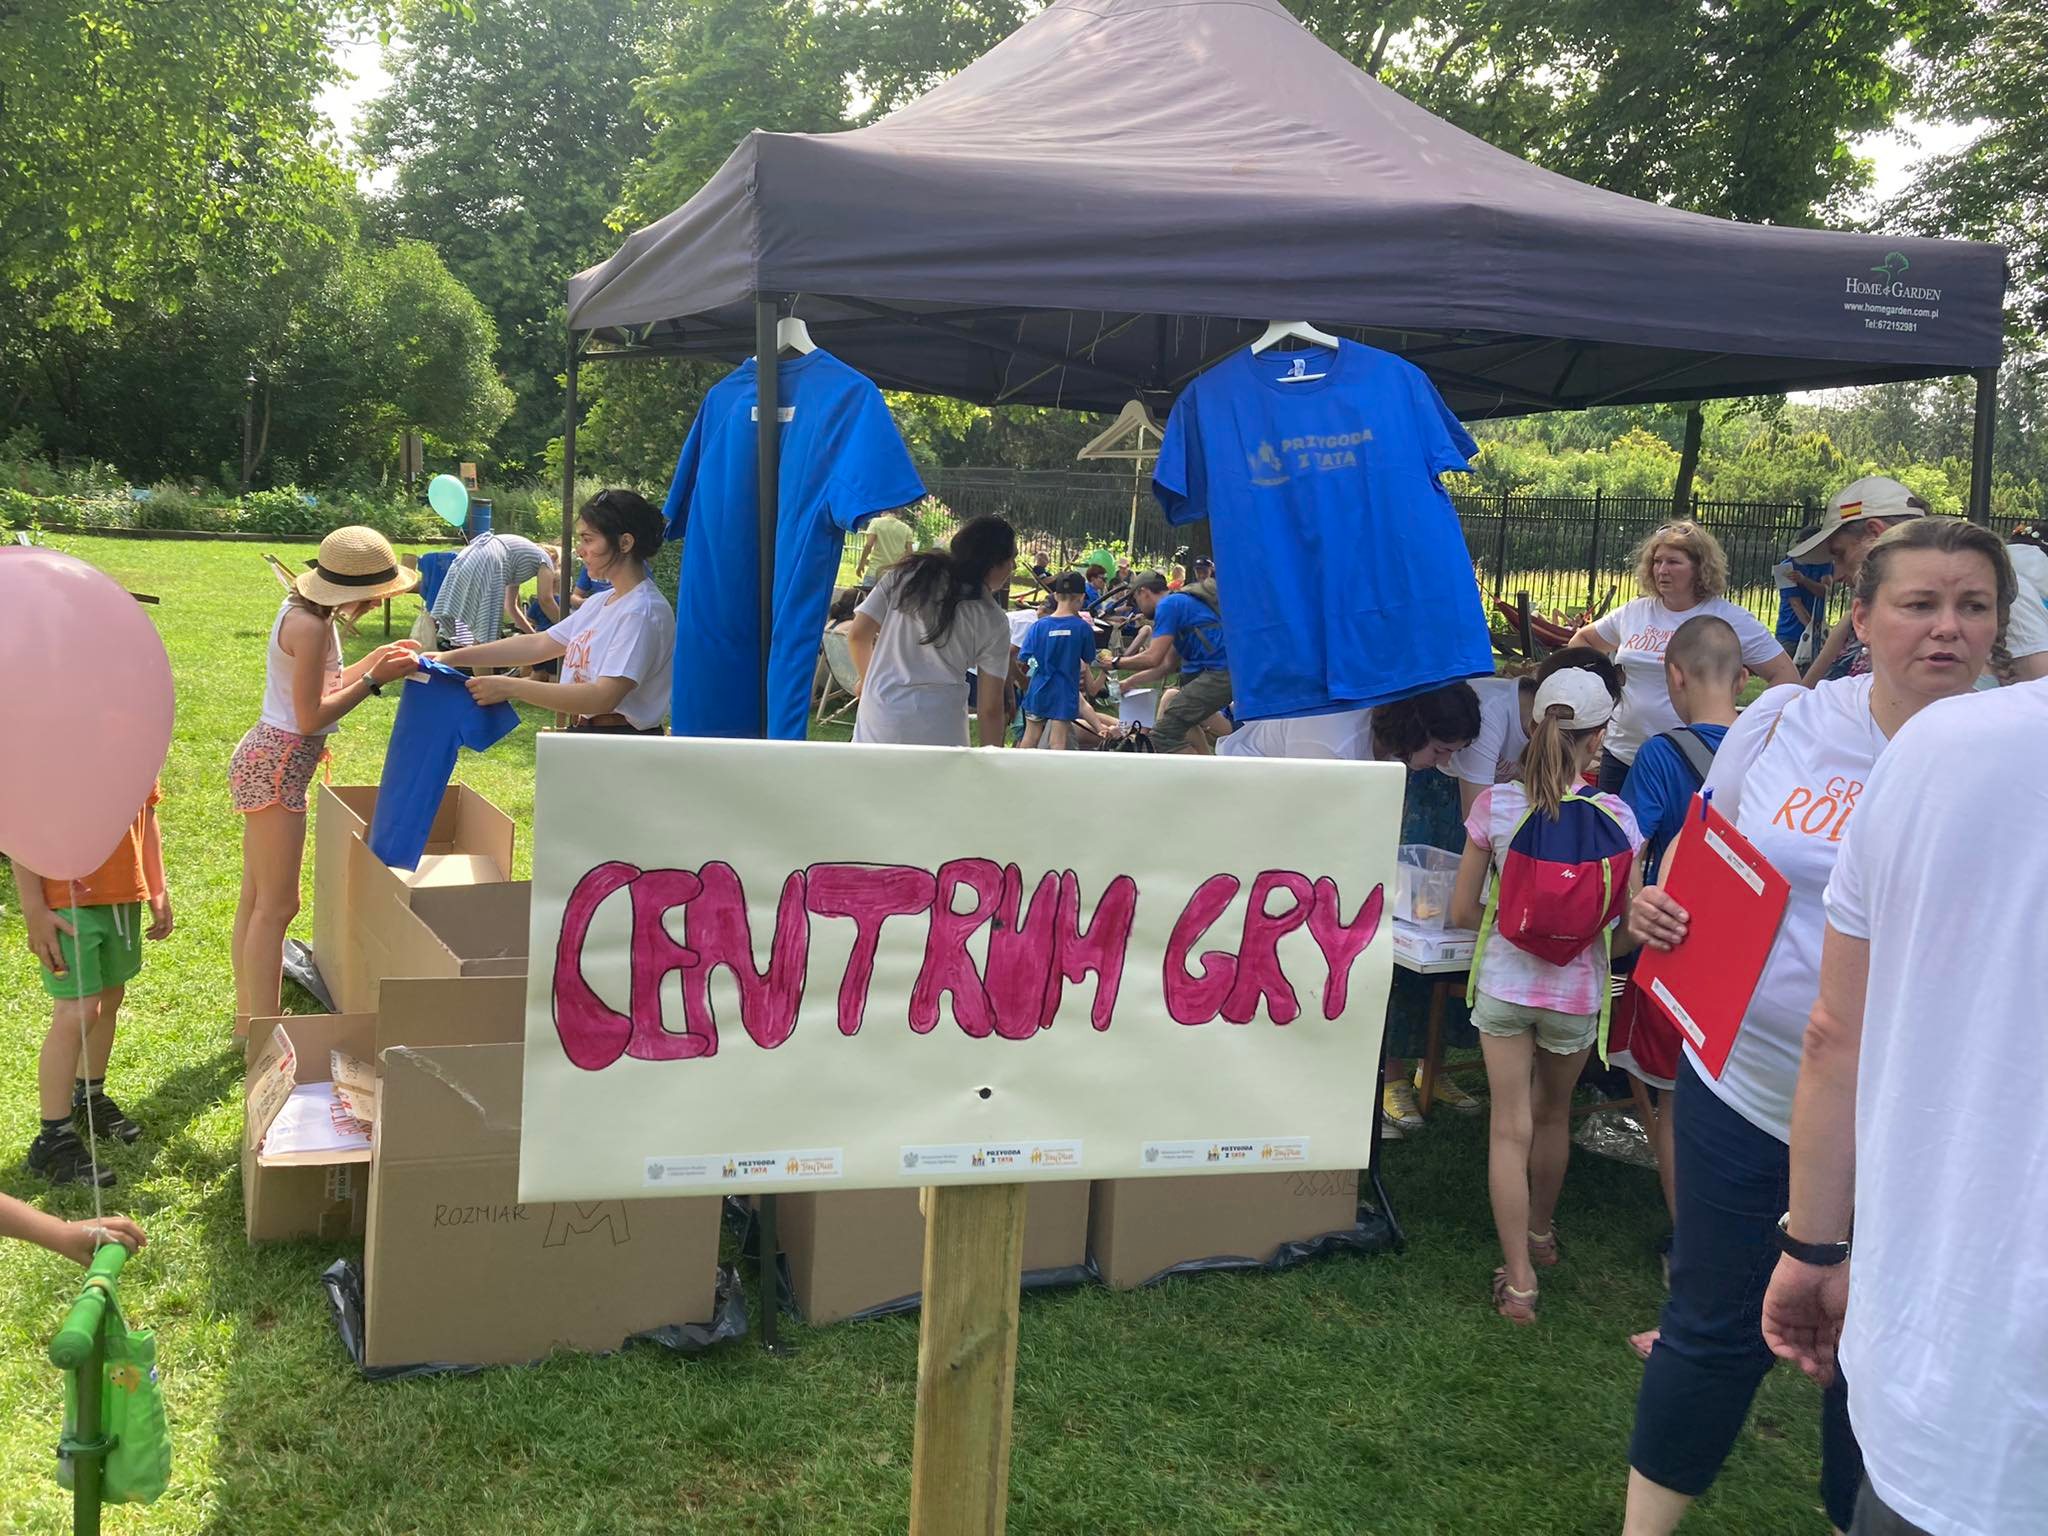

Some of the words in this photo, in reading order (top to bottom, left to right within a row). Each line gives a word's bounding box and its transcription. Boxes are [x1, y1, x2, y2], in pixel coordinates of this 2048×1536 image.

[1844, 302, 1939, 319] www.homegarden.com.pl
[553, 858, 1137, 1071] CENTRUM
[1162, 869, 1384, 1025] GRY
[433, 1202, 529, 1228] ROZMIAR
